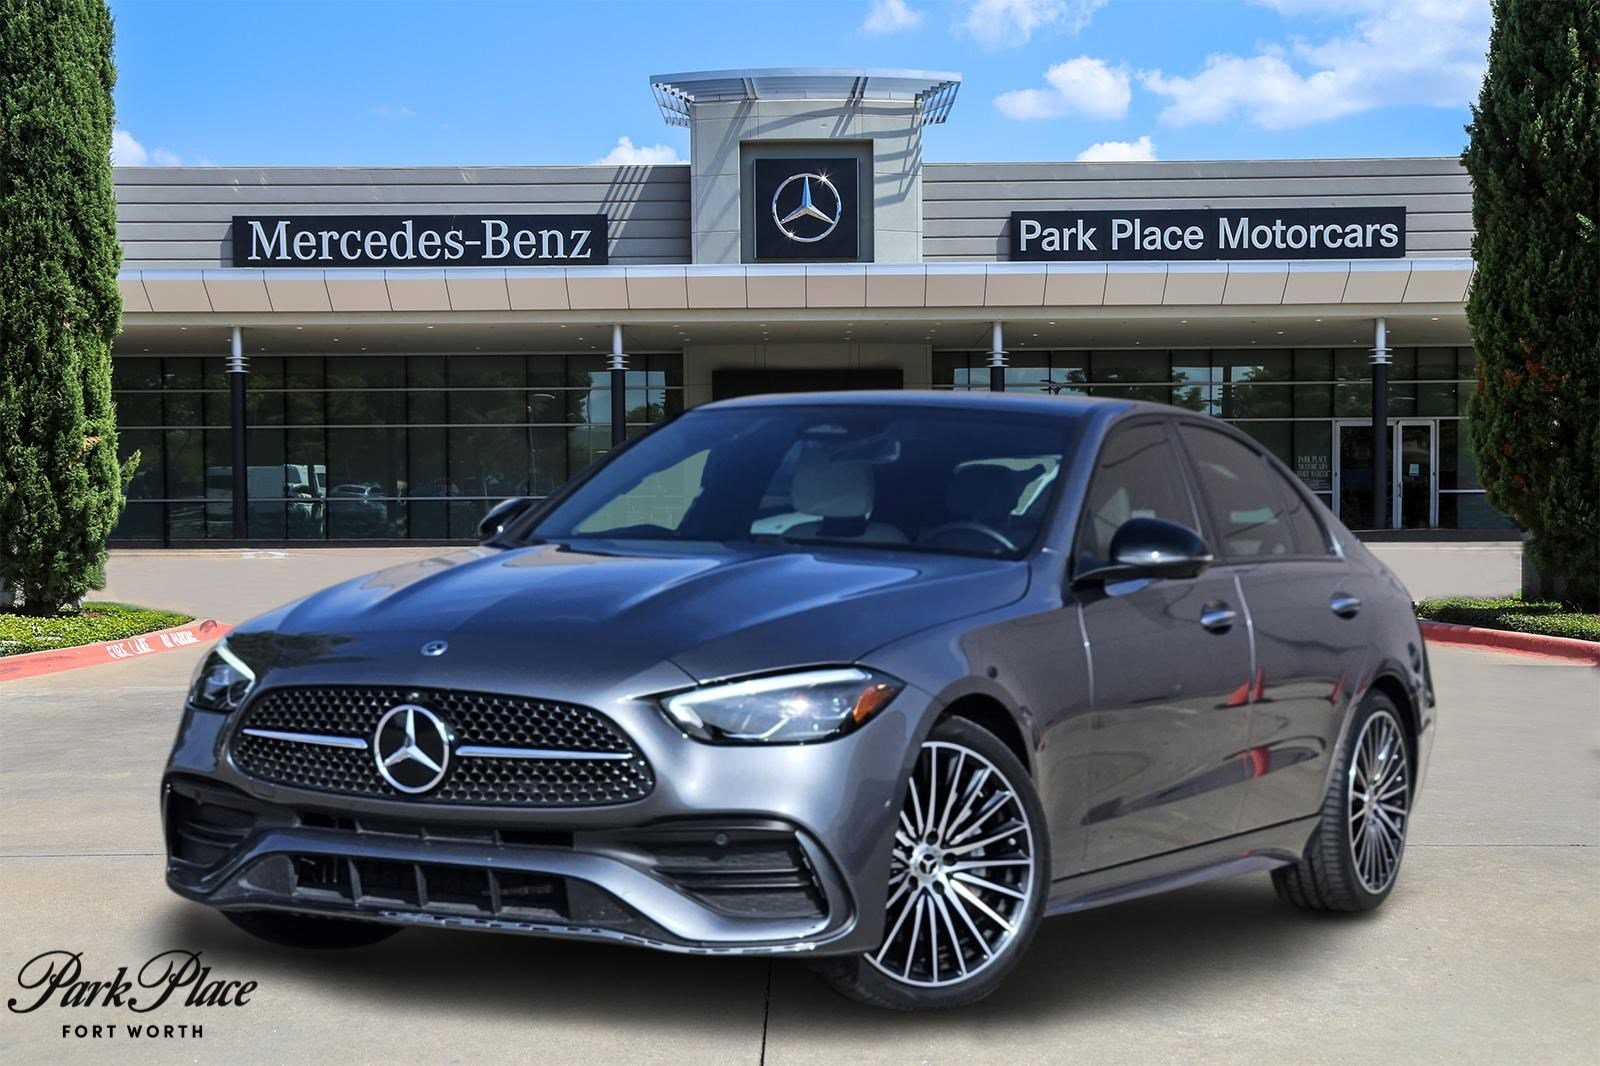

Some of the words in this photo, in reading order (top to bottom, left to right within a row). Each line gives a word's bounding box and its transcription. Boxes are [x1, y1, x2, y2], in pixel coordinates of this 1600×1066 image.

[248, 219, 592, 260] Mercedes-Benz
[1019, 219, 1098, 251] Park
[1111, 218, 1204, 251] Place
[1218, 217, 1399, 249] Motorcars
